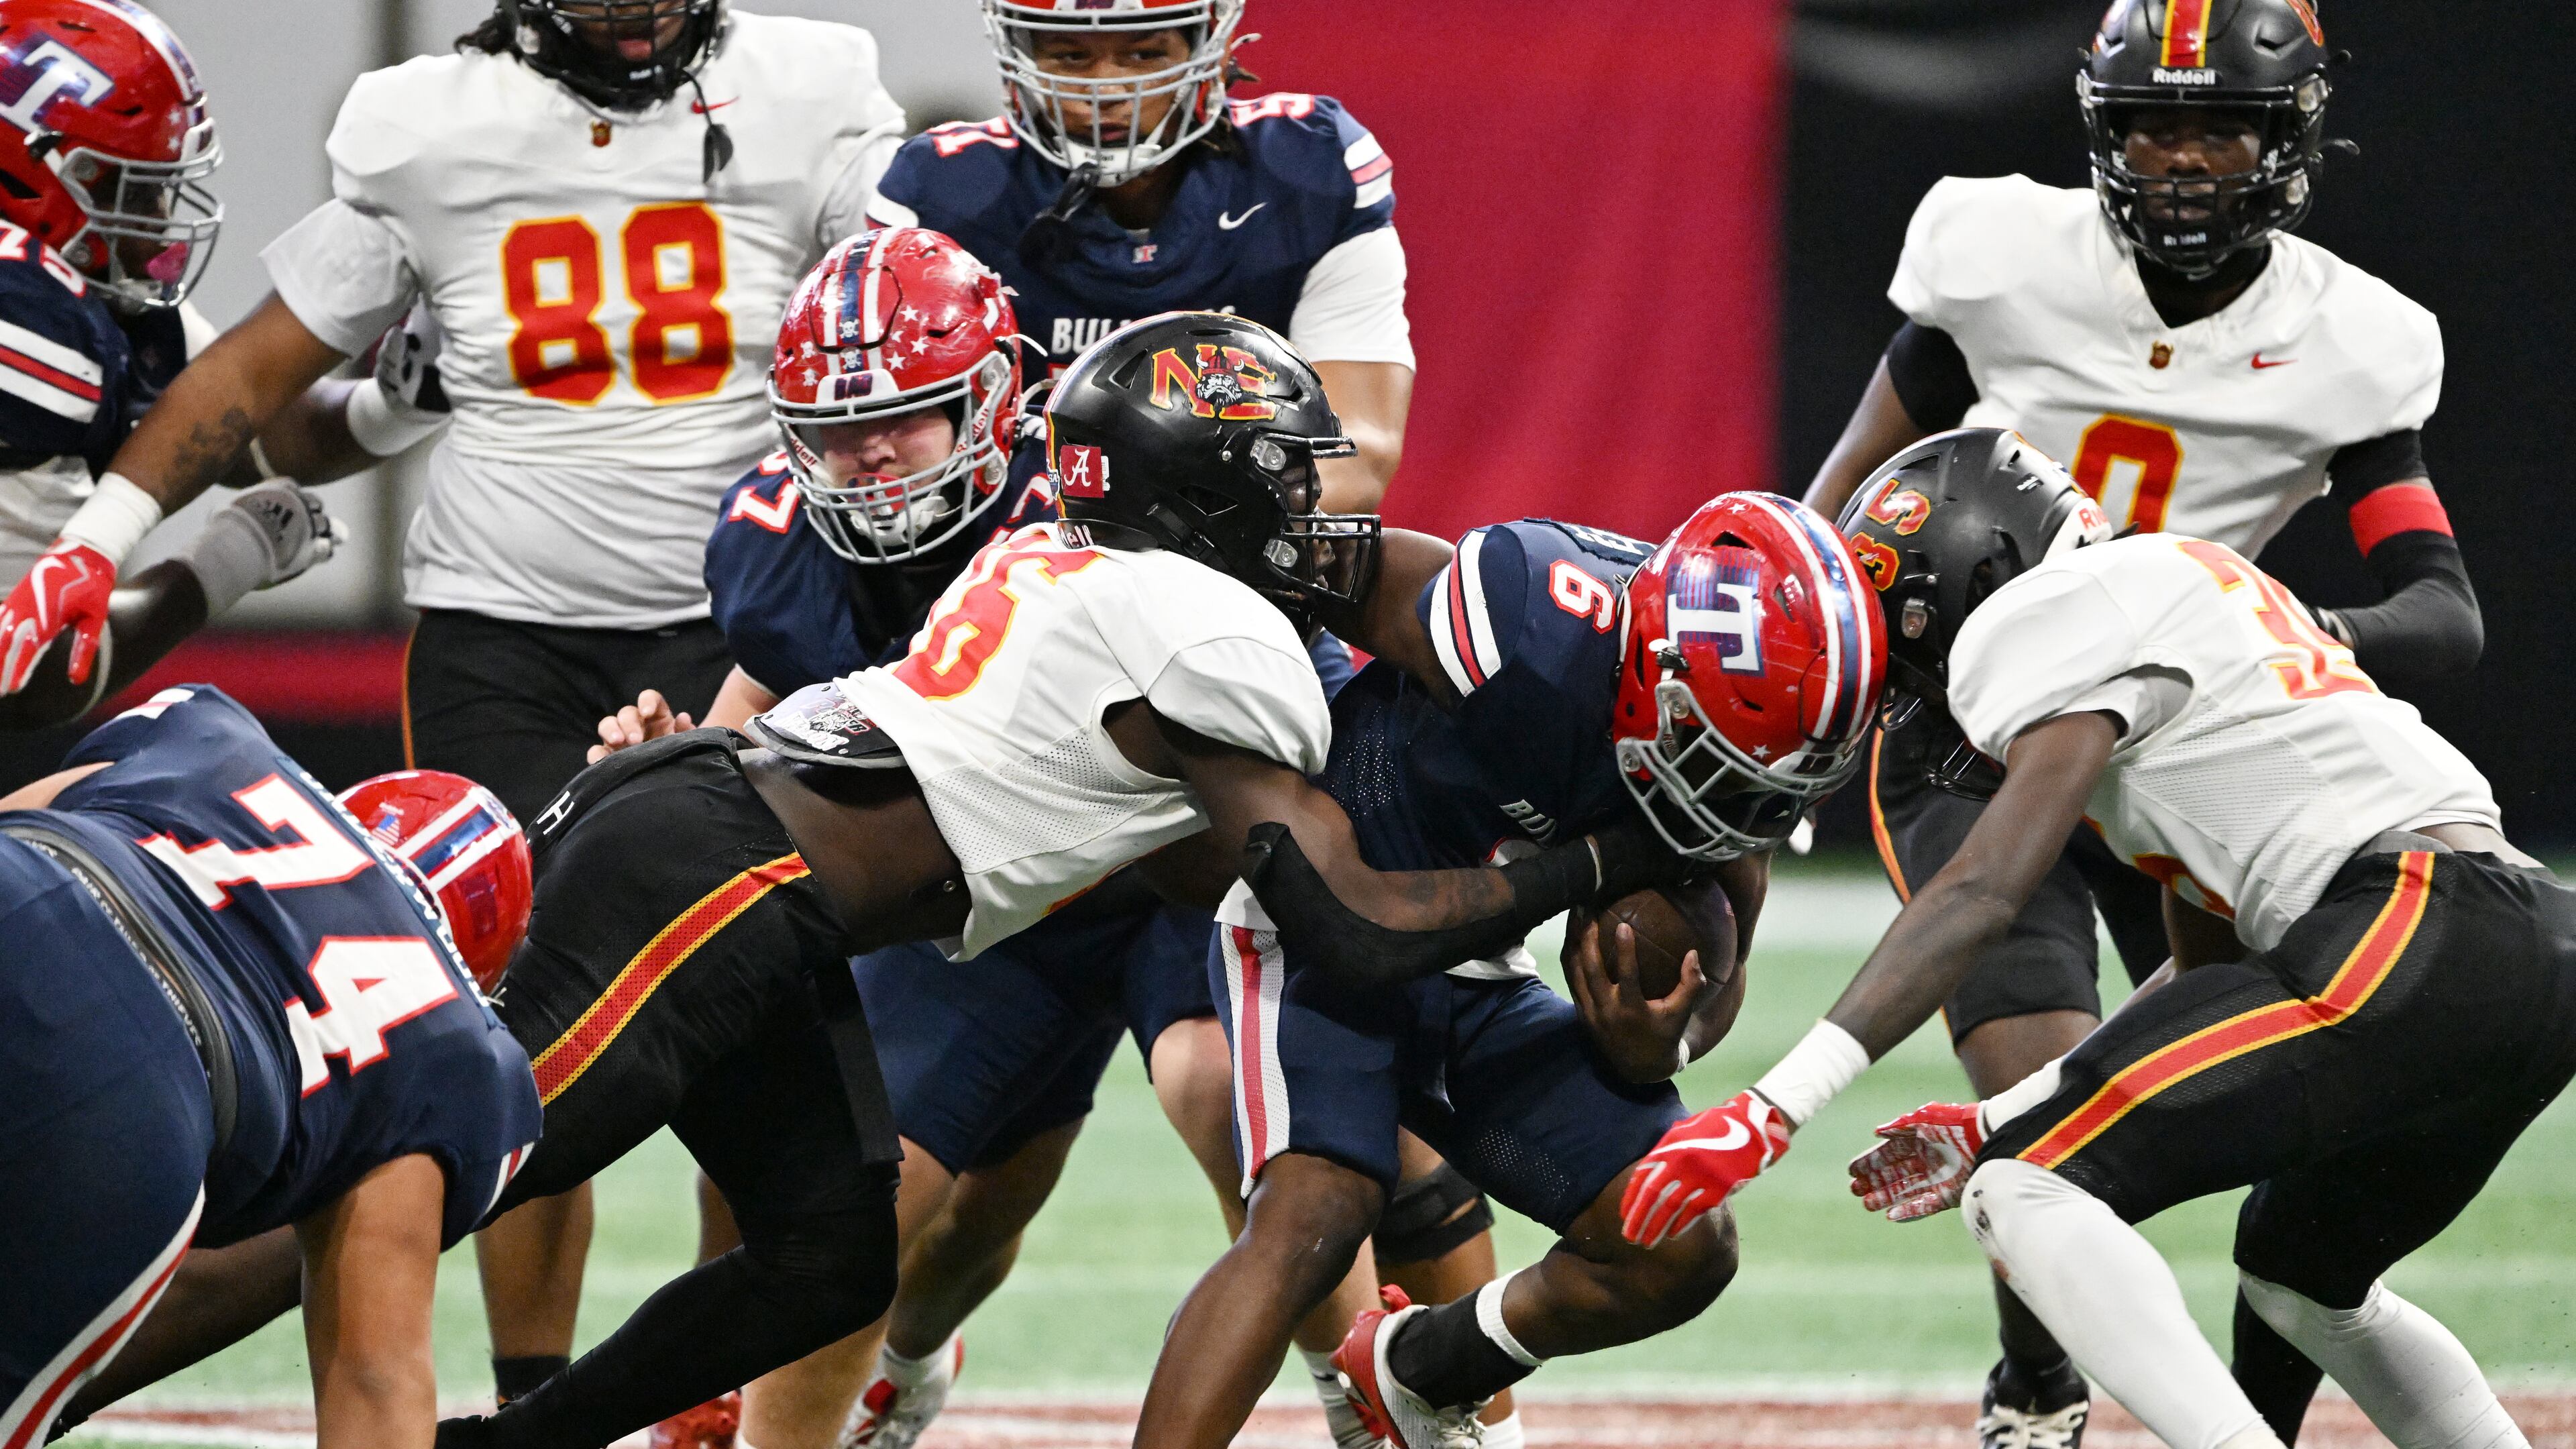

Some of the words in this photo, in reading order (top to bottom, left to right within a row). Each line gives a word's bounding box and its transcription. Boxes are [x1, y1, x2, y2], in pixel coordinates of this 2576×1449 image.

[2152, 68, 2216, 85] Riddell
[500, 198, 735, 407] 88
[1150, 344, 1276, 420] NE
[1063, 447, 1091, 488] A
[136, 773, 460, 1099] 74
